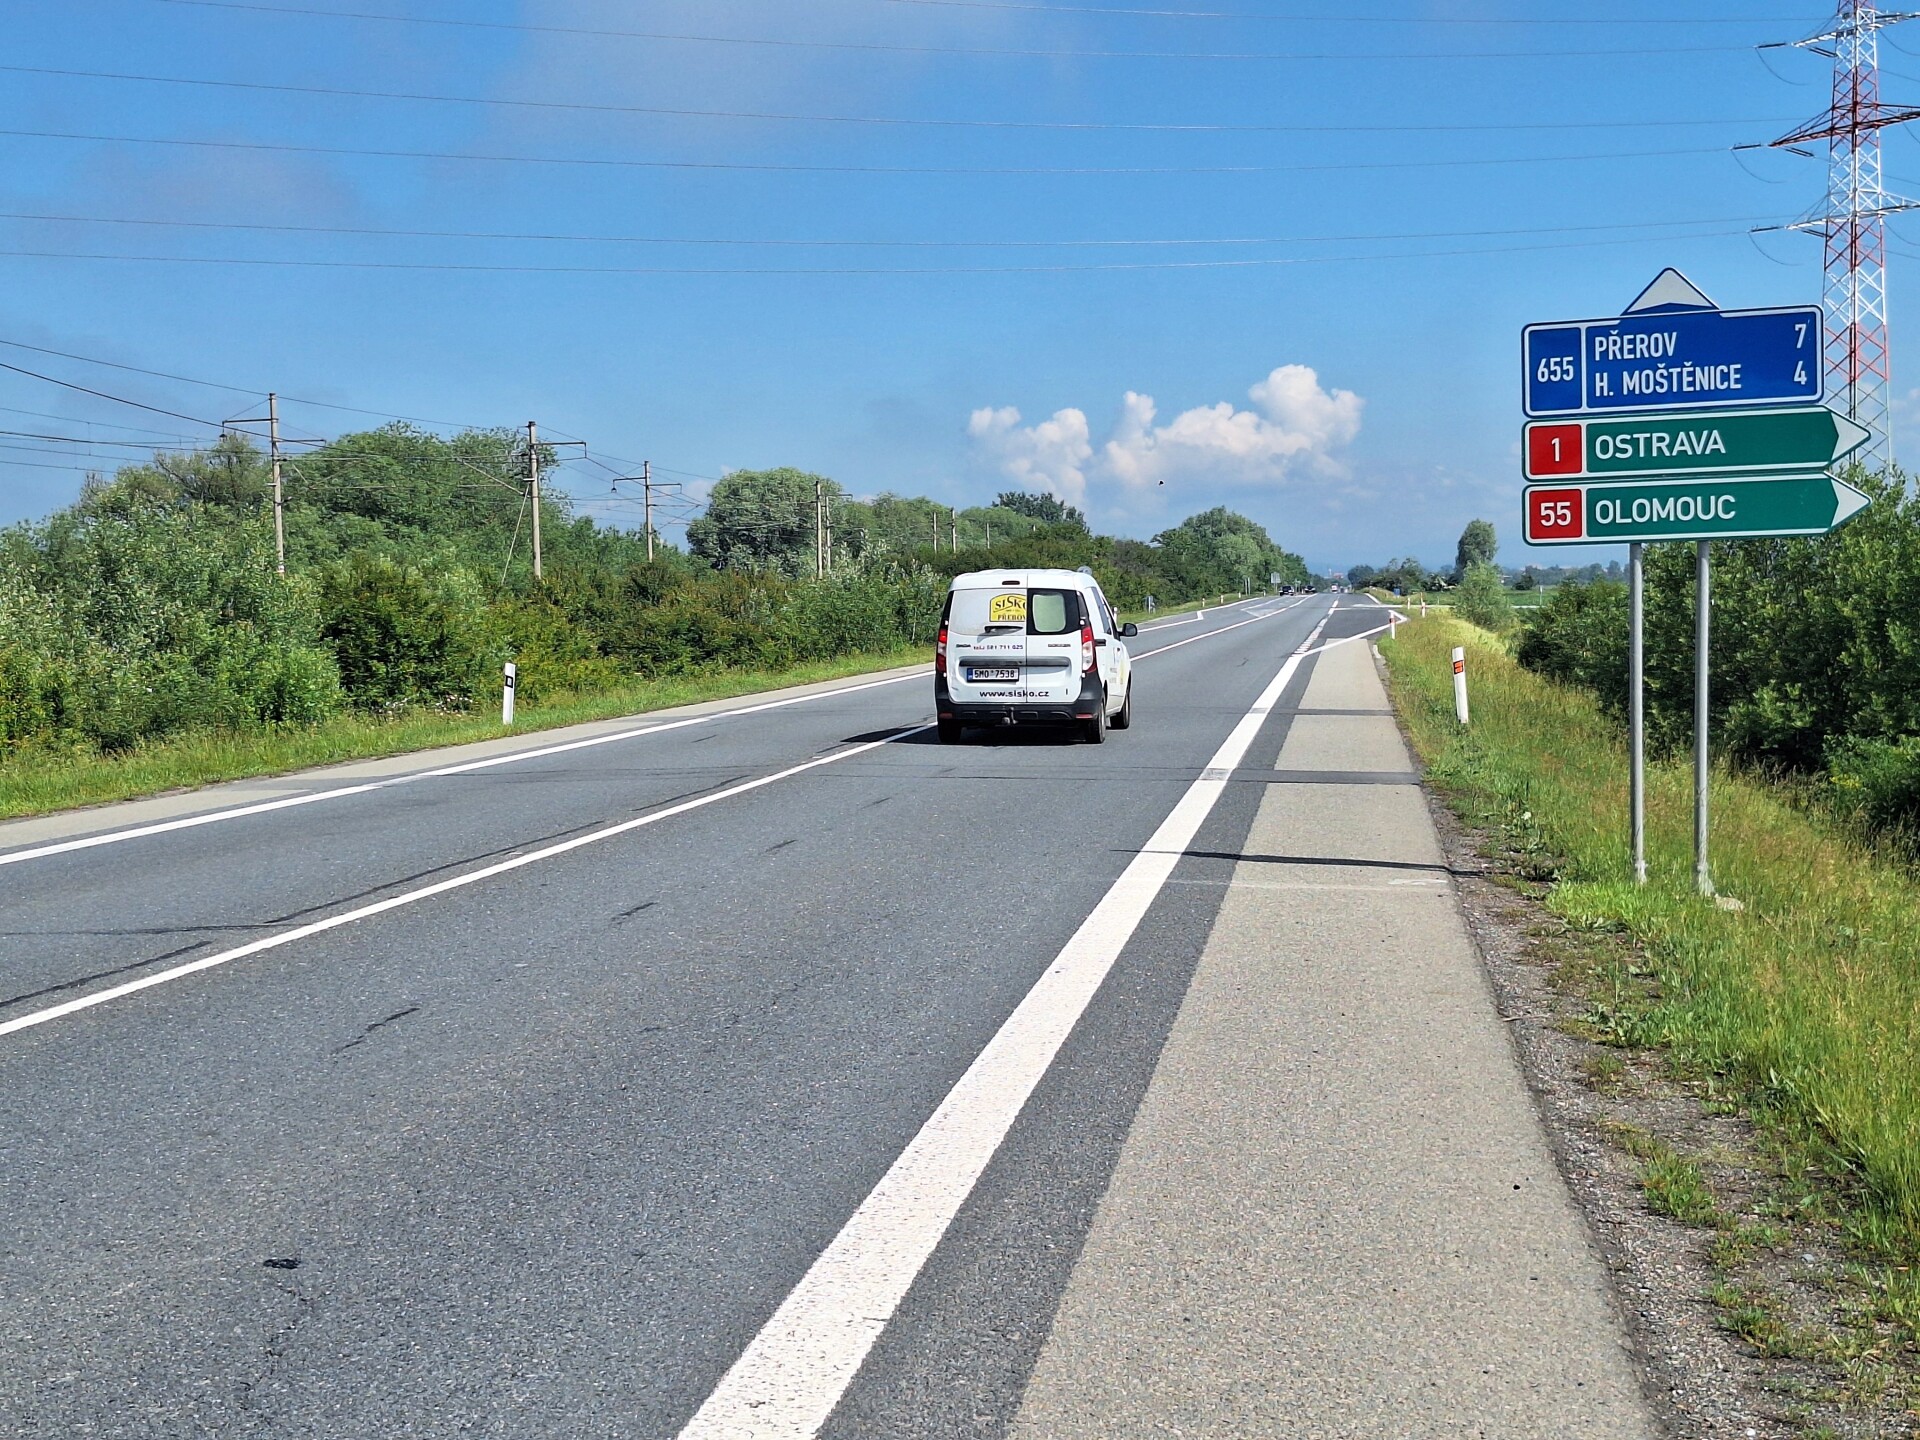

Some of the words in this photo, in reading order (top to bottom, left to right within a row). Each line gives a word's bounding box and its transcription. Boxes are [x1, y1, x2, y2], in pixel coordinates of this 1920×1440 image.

[1594, 330, 1677, 361] PŘEROV
[1794, 323, 1807, 349] 7
[1536, 356, 1574, 383] 655
[1595, 372, 1614, 397] H.
[1622, 361, 1742, 396] MOŠTĚNICE
[1793, 360, 1807, 385] 4
[1551, 437, 1560, 462] 1
[1594, 429, 1726, 460] OSTRAVA
[1540, 501, 1571, 527] 55
[1594, 495, 1736, 525] OLOMOUC
